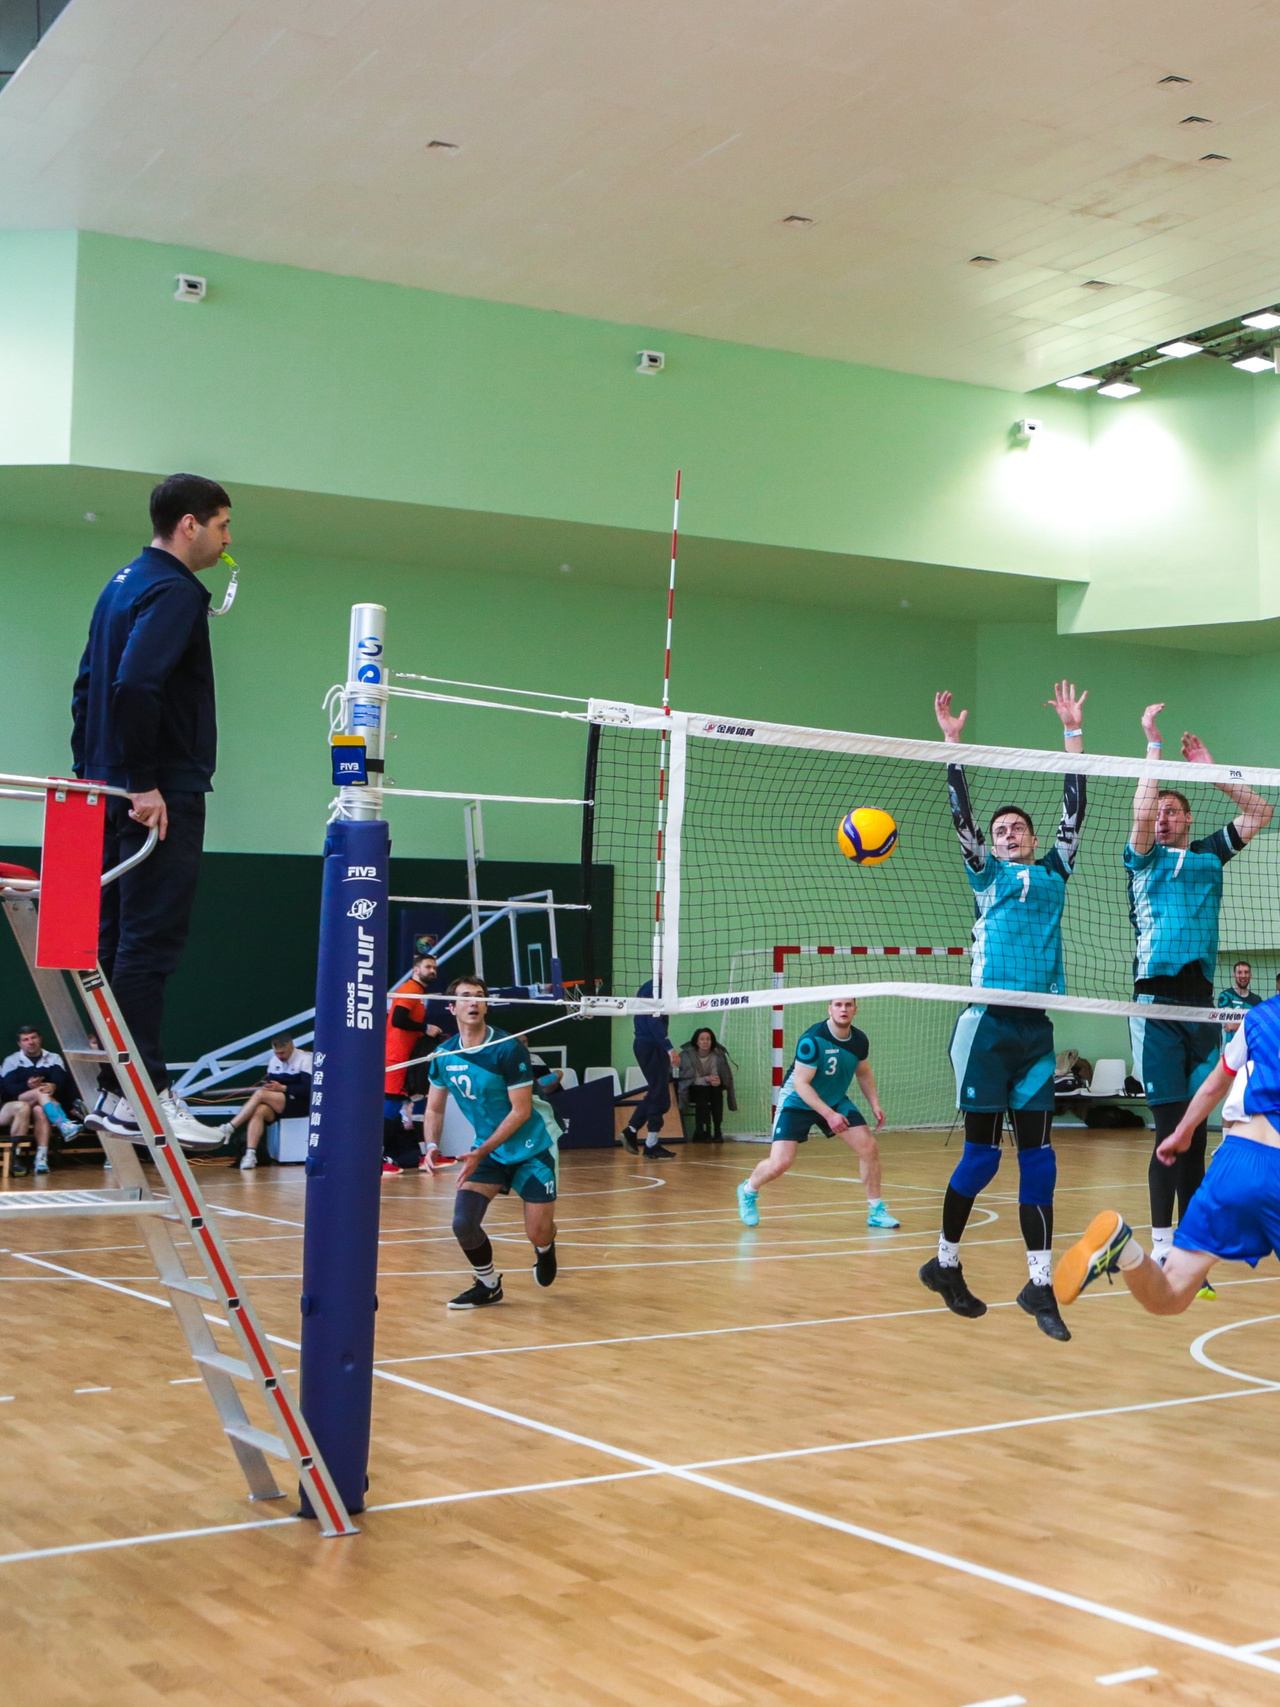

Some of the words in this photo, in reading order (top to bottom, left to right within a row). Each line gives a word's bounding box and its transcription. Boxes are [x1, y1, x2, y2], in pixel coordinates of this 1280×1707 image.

[340, 762, 359, 771] FIVB
[347, 866, 376, 877] FIVB
[1167, 848, 1187, 878] 7
[346, 982, 355, 1028] SPORTS
[824, 1056, 838, 1076] 3
[450, 1074, 476, 1100] 12
[544, 1180, 555, 1195] 12
